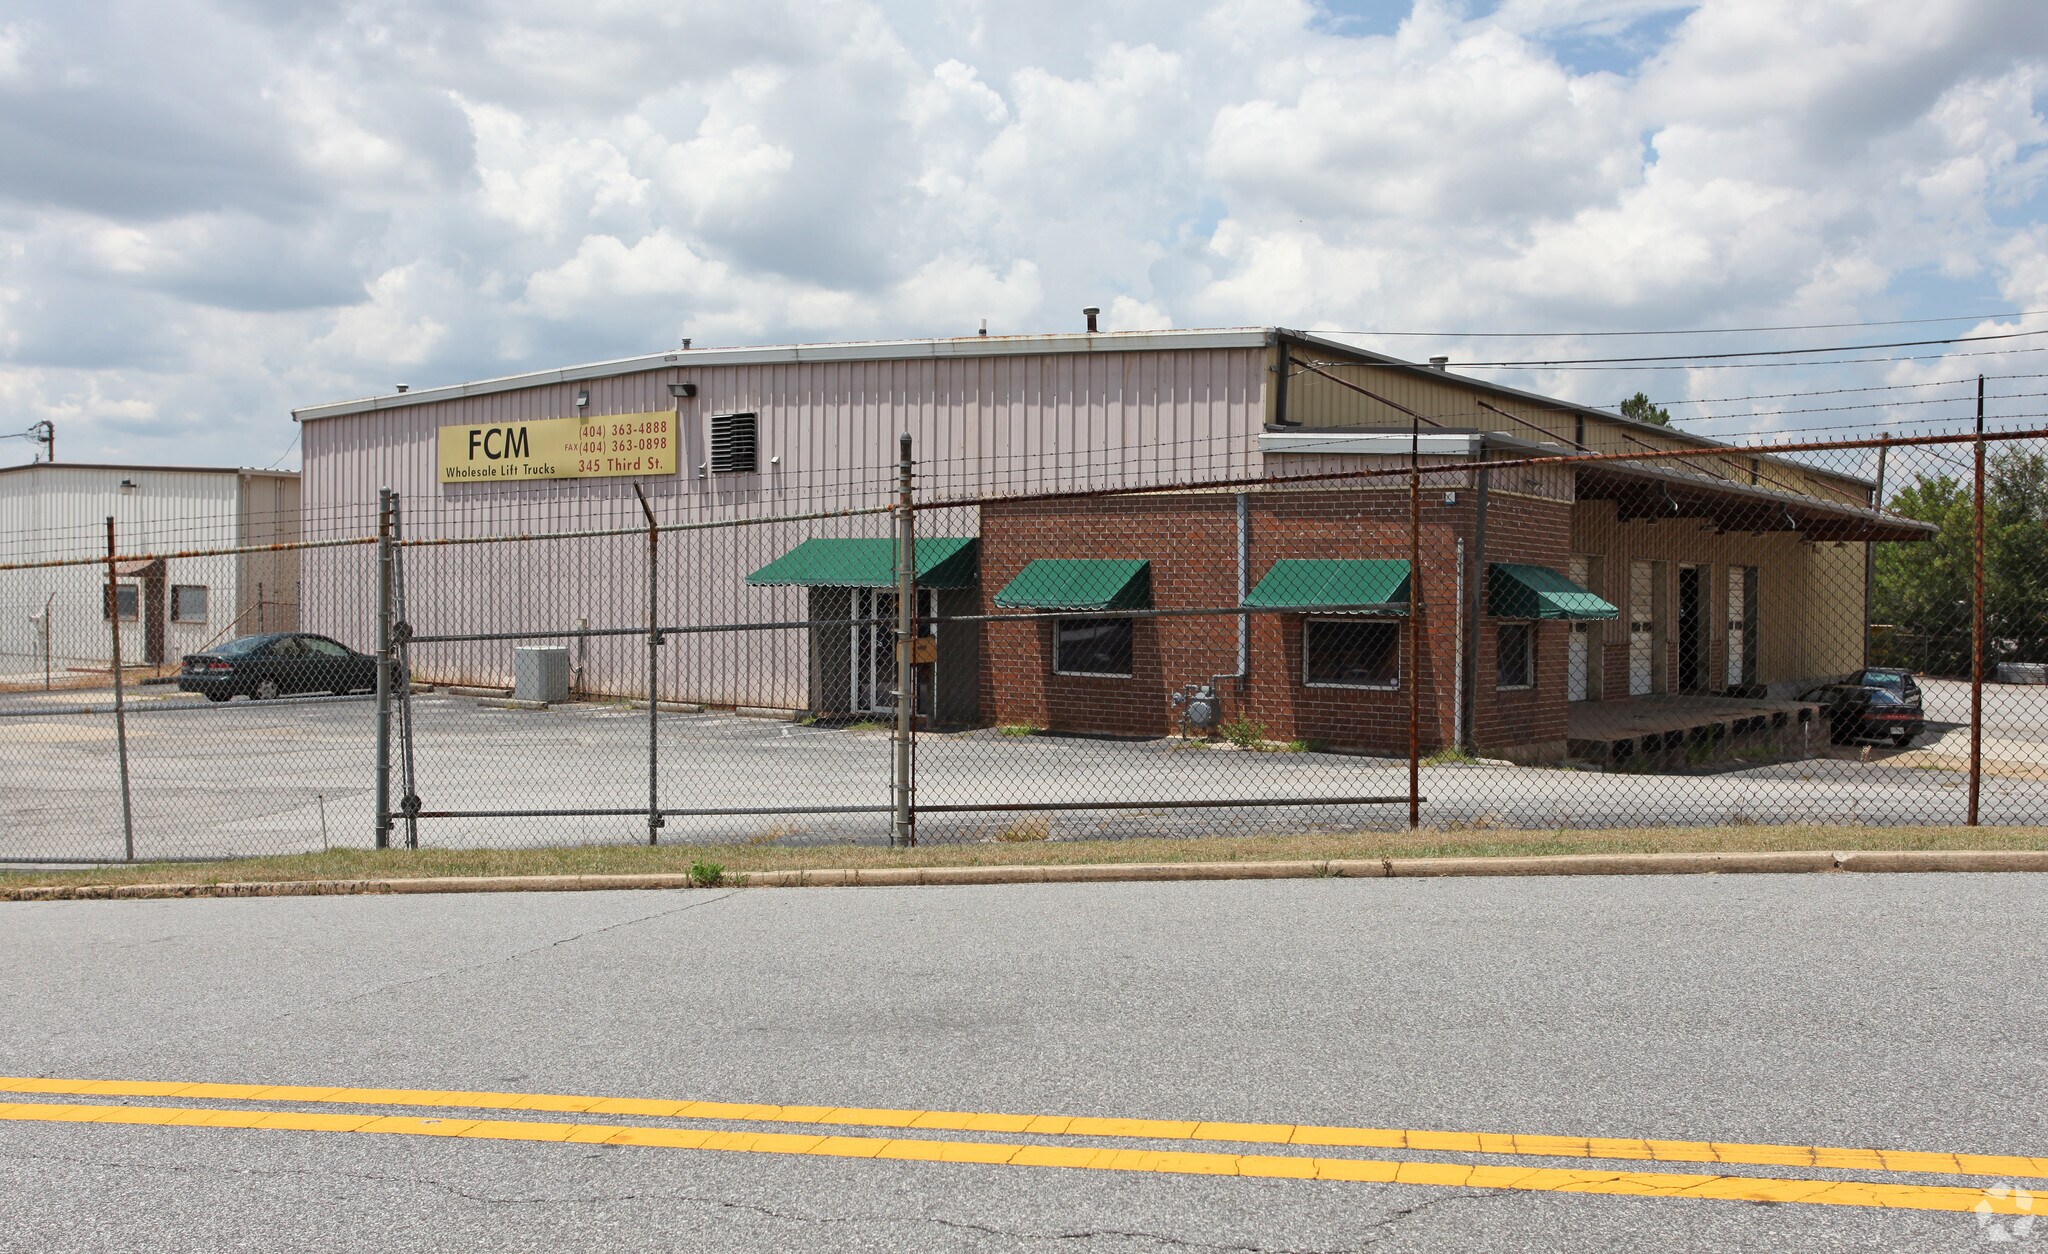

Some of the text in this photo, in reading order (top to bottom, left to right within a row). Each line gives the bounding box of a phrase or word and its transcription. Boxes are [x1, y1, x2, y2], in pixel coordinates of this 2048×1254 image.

[579, 421, 667, 440] (404) 363-4888
[469, 426, 530, 461] FCM
[612, 437, 667, 452] 363-0898
[446, 463, 556, 478] Wholesale Lift Trucks
[578, 456, 663, 472] 345 Third St.
